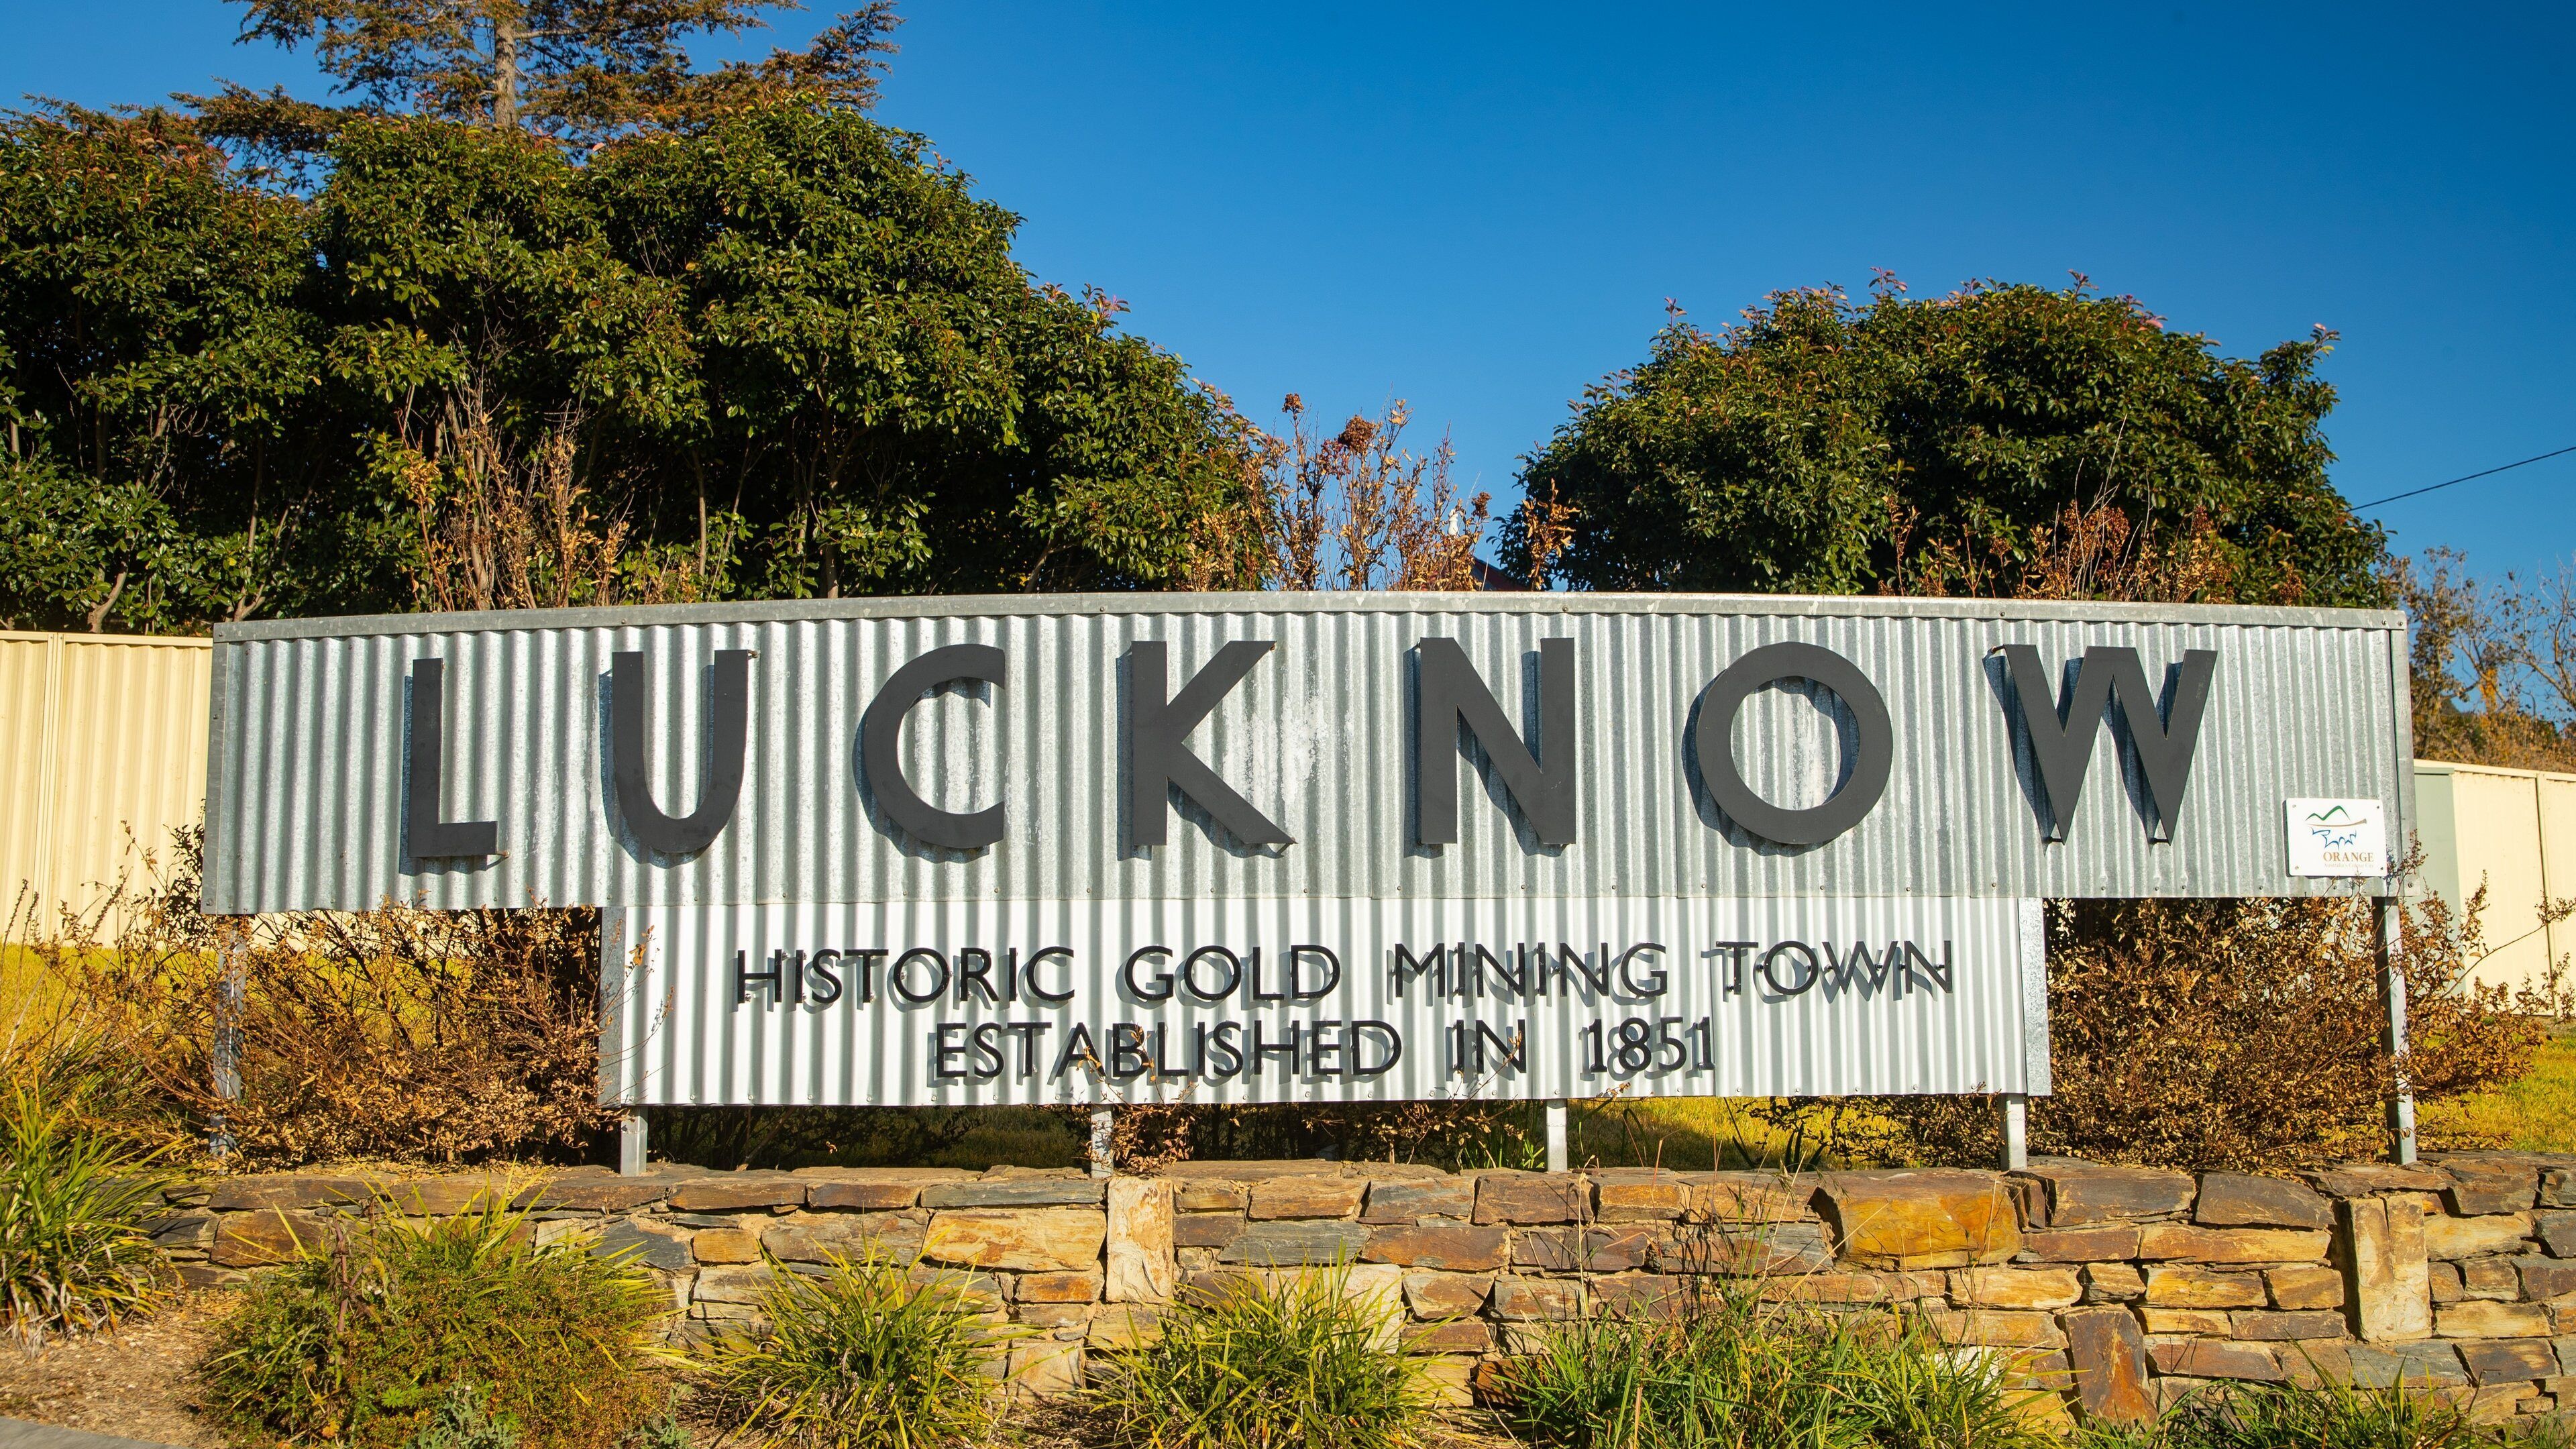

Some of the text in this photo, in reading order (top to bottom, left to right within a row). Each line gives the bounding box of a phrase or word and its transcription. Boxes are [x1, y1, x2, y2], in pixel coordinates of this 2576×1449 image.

[408, 637, 2218, 857] LUCKNOW
[2323, 851, 2374, 862] ORANGE
[737, 940, 1953, 1004] HISTORIC GOLD MINING TOWN
[936, 1016, 1715, 1077] ESTABLISHED IN 1851
